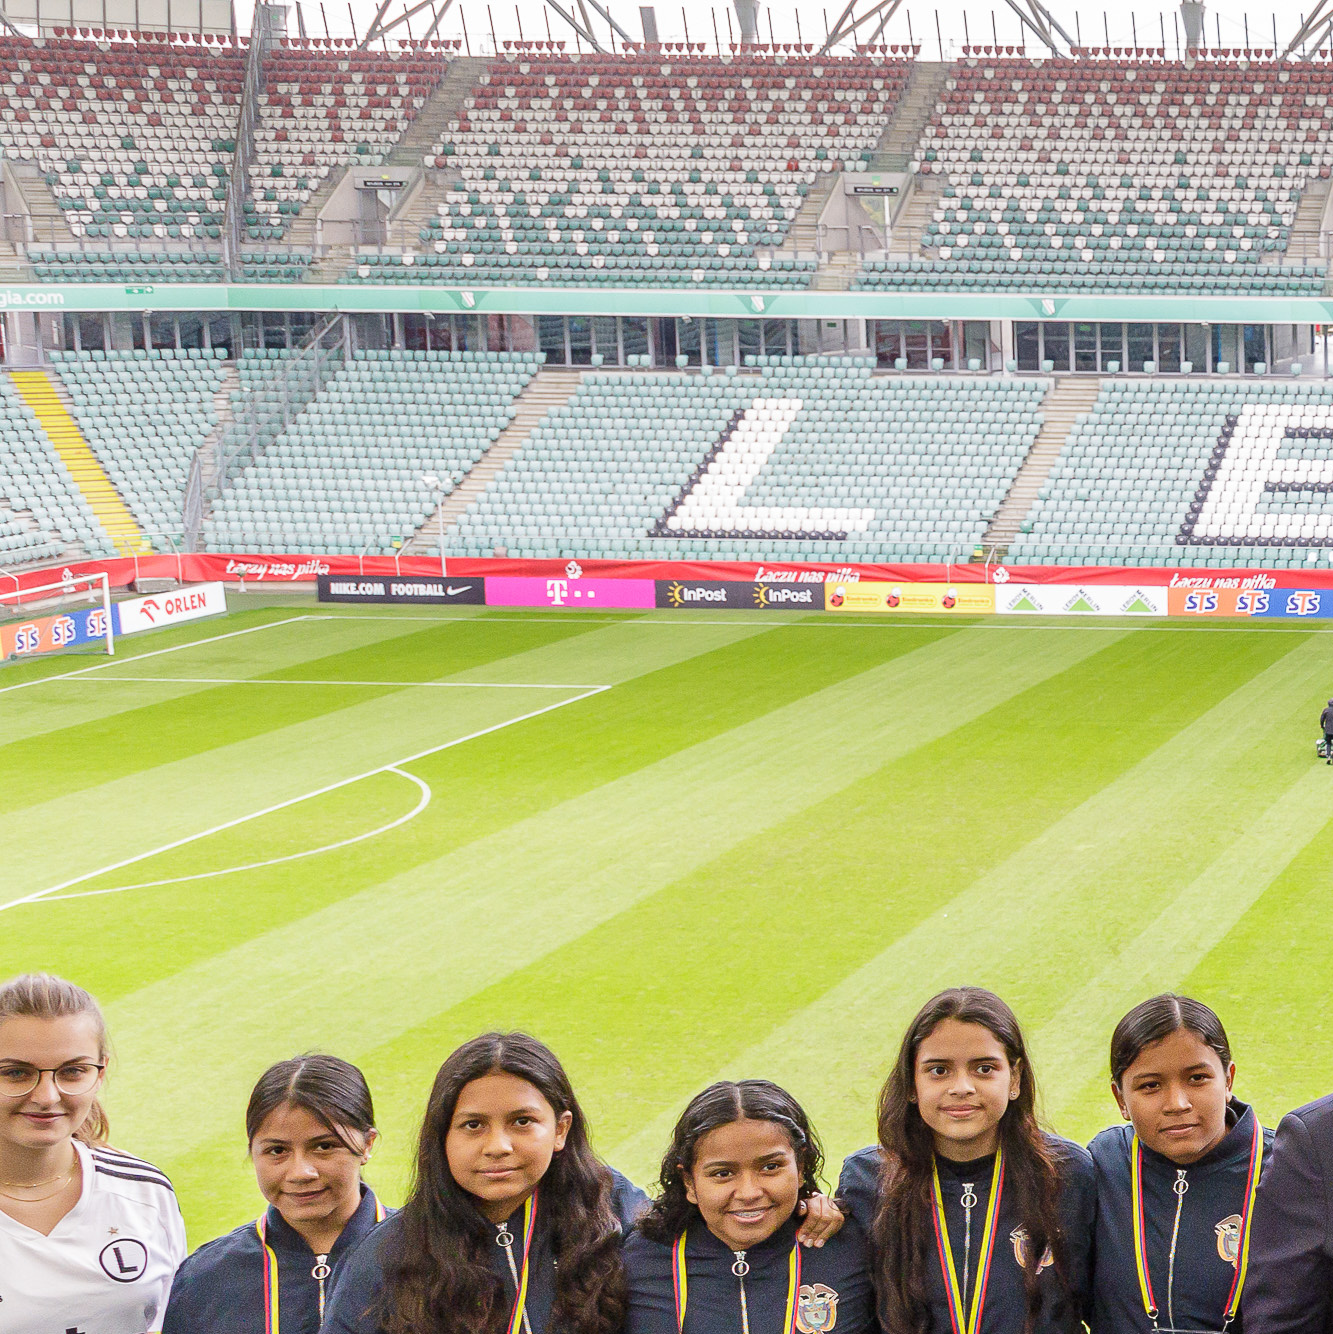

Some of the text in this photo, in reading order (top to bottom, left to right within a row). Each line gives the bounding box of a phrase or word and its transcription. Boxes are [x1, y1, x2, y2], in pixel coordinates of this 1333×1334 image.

[268, 563, 296, 576] nas
[329, 582, 445, 597] NIKE.COM FOOTBALL
[683, 587, 727, 602] InPost
[768, 588, 813, 603] InPost
[165, 593, 206, 615] ORLEN
[1185, 590, 1218, 613] STS
[1236, 591, 1269, 614] STS
[1286, 591, 1320, 614] STS
[16, 625, 39, 652] STS
[53, 616, 75, 643] STS
[113, 1247, 138, 1273] L
